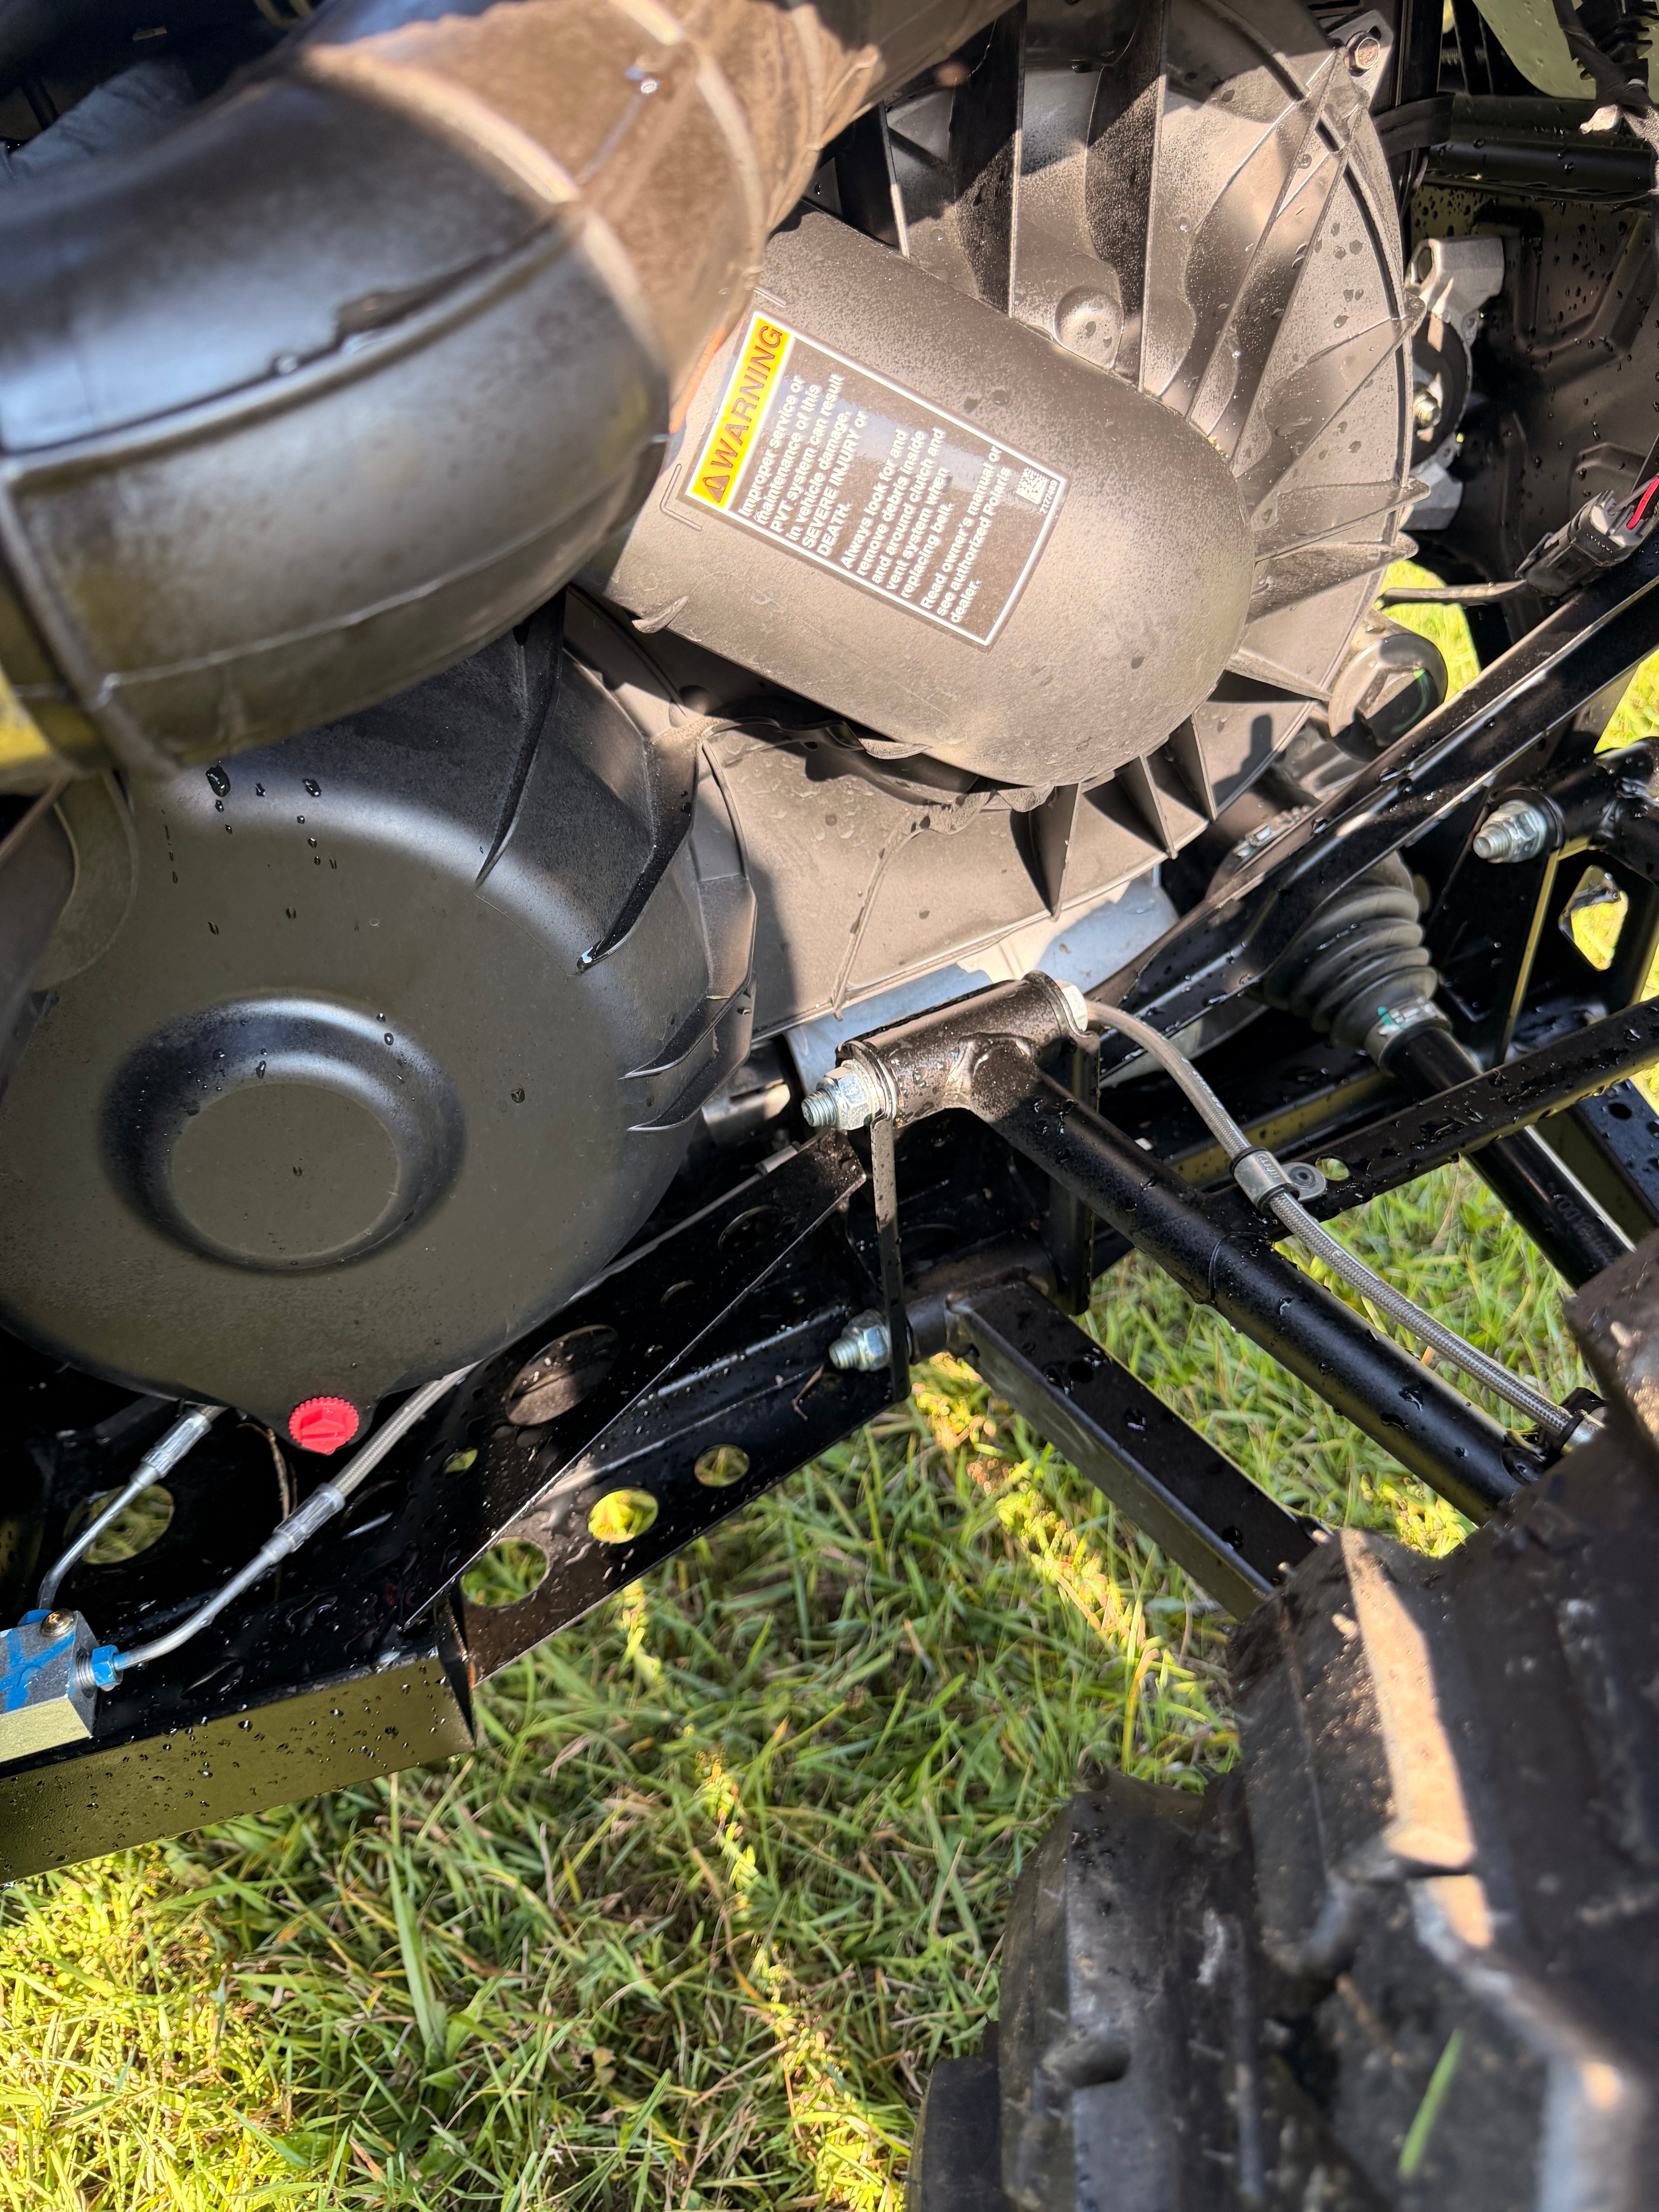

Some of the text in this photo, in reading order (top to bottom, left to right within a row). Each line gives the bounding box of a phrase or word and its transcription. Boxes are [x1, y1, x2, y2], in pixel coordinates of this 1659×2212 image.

[710, 326, 782, 468] WARNING
[738, 375, 803, 516] Improper service or
[756, 385, 819, 524] maintenance of this
[770, 374, 843, 532] PVT system can result
[785, 526, 802, 540] in
[795, 472, 823, 522] vehicle
[802, 410, 868, 548] SEVERE INJURY or
[817, 503, 850, 556] DEATH.
[841, 429, 908, 569] Always look for and
[857, 431, 925, 575] remove debris inside
[872, 428, 944, 583] and around clutch and
[886, 467, 950, 589] vent system when
[920, 445, 1001, 609] Read owner's manual or
[937, 467, 1010, 616] see authorized Polaris
[901, 503, 952, 598] replacing belt.
[950, 580, 979, 623] dealer.
